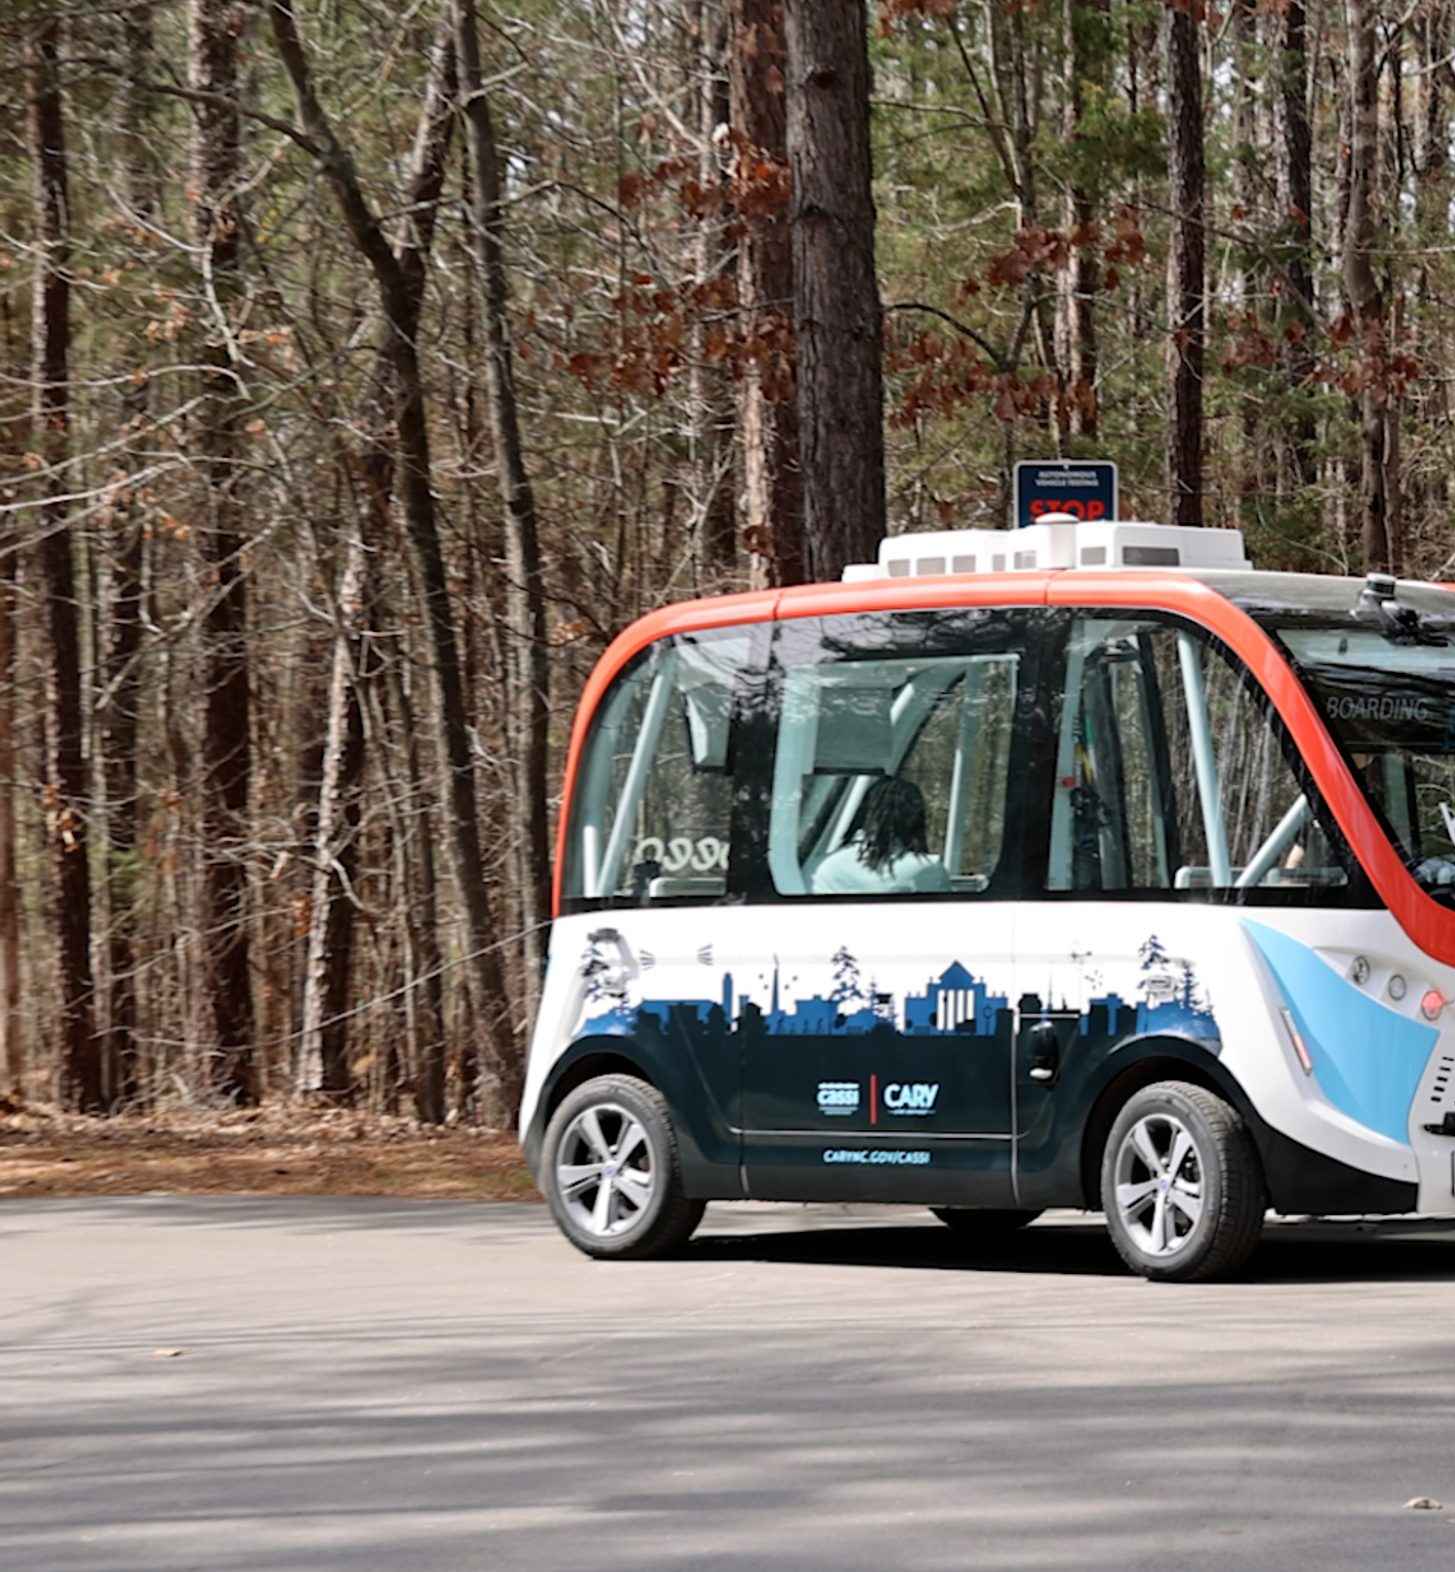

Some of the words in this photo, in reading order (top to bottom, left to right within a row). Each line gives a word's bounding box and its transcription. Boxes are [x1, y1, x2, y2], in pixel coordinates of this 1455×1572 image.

[1029, 500, 1105, 523] STOP
[1326, 696, 1430, 720] BOARDING
[884, 1083, 940, 1108] CARY
[823, 1149, 931, 1164] CARYNC.GOV/CASSI
